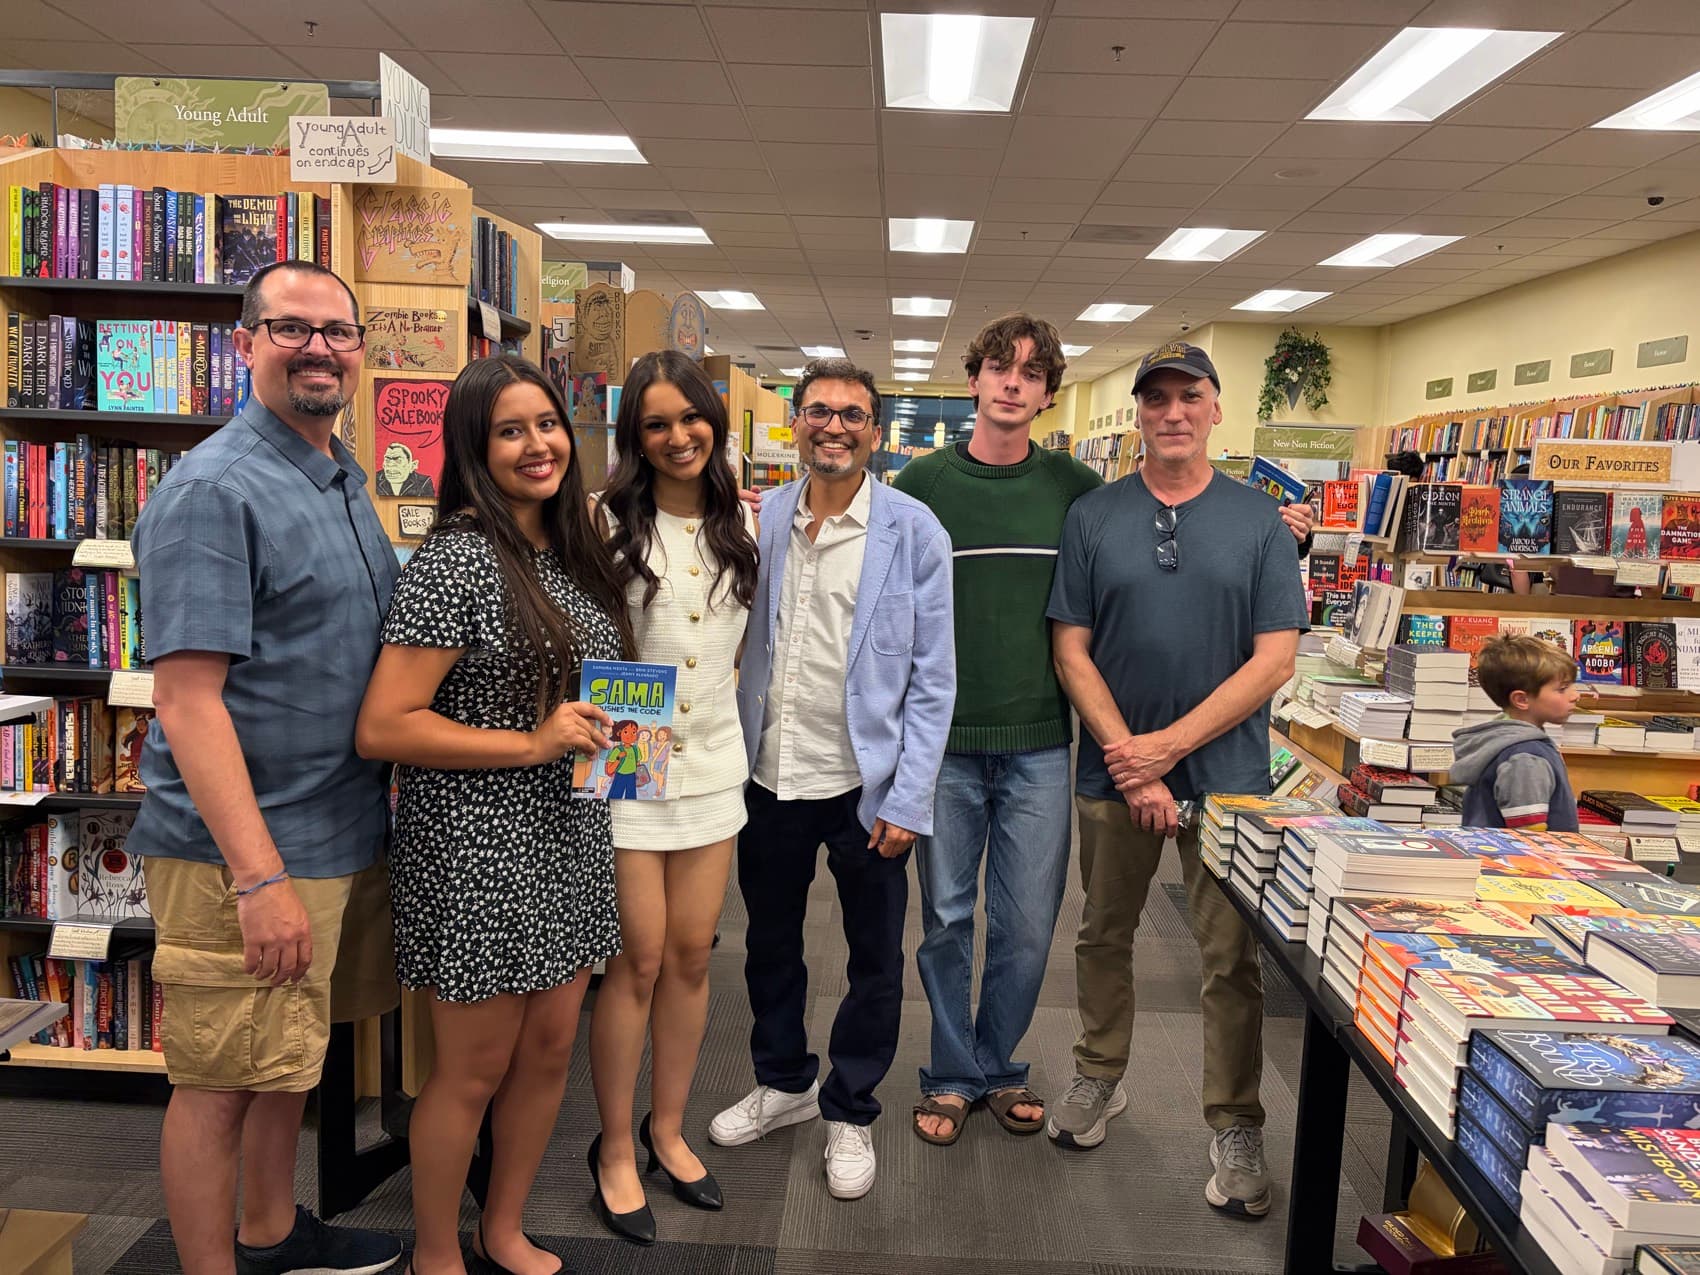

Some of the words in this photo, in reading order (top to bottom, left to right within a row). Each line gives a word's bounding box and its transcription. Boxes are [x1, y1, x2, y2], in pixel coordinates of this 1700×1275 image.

[384, 59, 428, 124] YOUNG
[174, 105, 222, 126] Young
[226, 107, 268, 123] Adult
[309, 146, 370, 157] continues
[296, 159, 312, 168] on
[314, 156, 366, 177] endcap
[40, 196, 49, 228] SHADOW
[153, 192, 164, 212] Soul
[228, 199, 242, 209] THE
[355, 186, 453, 228] Classic
[166, 194, 177, 241] MOONSICK
[242, 211, 275, 227] LIGHT
[40, 230, 49, 257] REAPER
[153, 222, 164, 253] Shadow
[185, 240, 193, 256] HOME
[541, 277, 570, 288] eligion
[367, 308, 408, 323] Zombie
[98, 323, 148, 334] BETTING
[22, 336, 33, 366] DARK
[36, 335, 47, 366] DARK
[116, 338, 134, 350] ON
[194, 340, 206, 388] MURTAGH
[22, 370, 33, 396] HEIR
[36, 369, 47, 396] HEIR
[100, 370, 152, 392] YOU
[387, 387, 447, 408] SPOOKY
[1273, 439, 1290, 448] New
[1291, 440, 1308, 449] Non
[1310, 440, 1335, 450] Fiction
[97, 468, 106, 501] TREACHERY
[1502, 489, 1549, 501] STRANGE
[401, 508, 420, 518] SALE
[1502, 501, 1547, 513] ANIMALS
[1562, 503, 1603, 512] ENDURANCE
[96, 509, 105, 529] SWANS
[89, 585, 97, 598] her
[1468, 617, 1493, 625] KUANG
[1409, 631, 1444, 639] KEEPER
[90, 642, 98, 654] sky
[1581, 644, 1619, 656] ARSENIC
[1585, 658, 1615, 668] ADOBO
[590, 677, 665, 708] SAMA
[639, 708, 662, 716] CODE
[98, 976, 108, 1006] MEDICI
[1500, 975, 1582, 1015] WORLD
[1534, 974, 1597, 998] RULE
[1577, 999, 1635, 1023] THE
[1573, 977, 1638, 999] HOW
[1620, 1002, 1670, 1017] TO
[98, 1006, 108, 1028] HEIST
[1497, 1030, 1603, 1086] BOUND
[1558, 1040, 1622, 1079] FURY
[1620, 1128, 1700, 1200] MISTBORN
